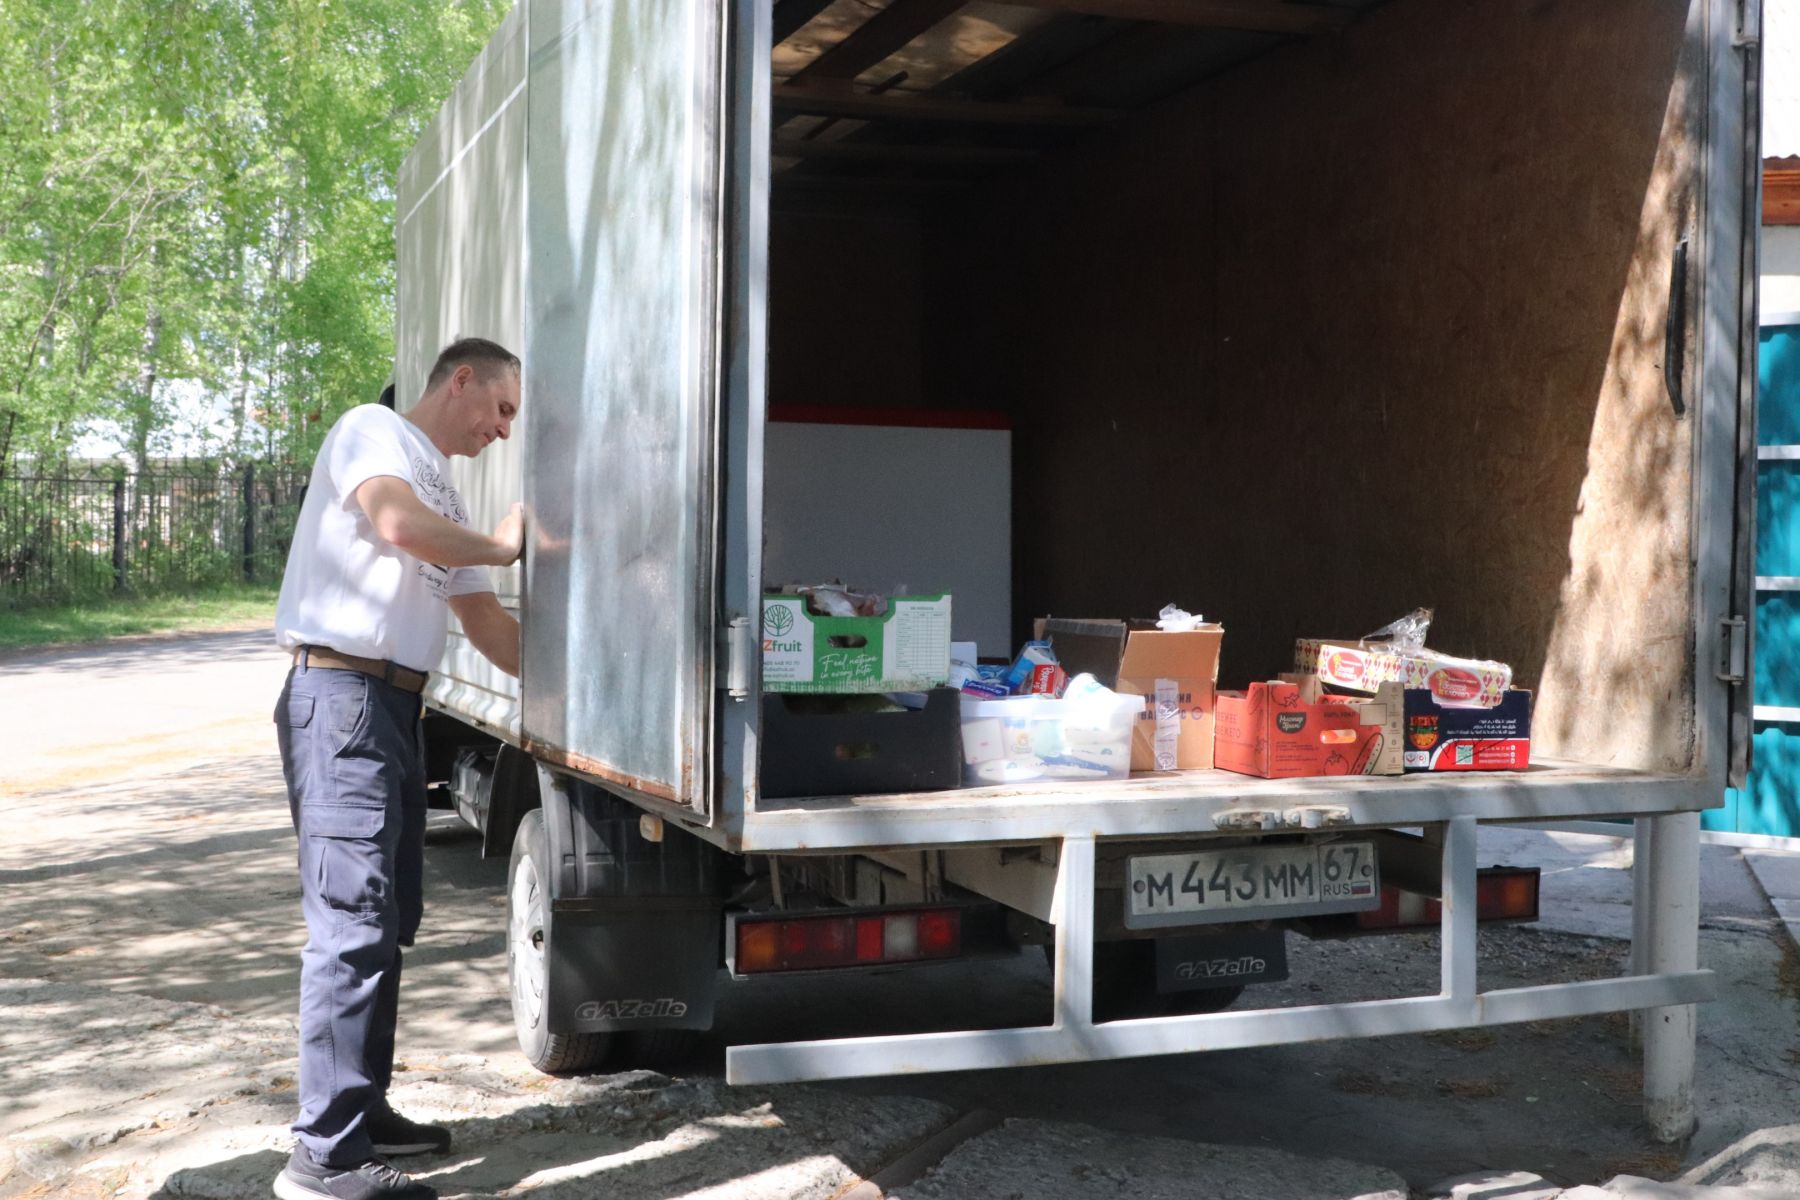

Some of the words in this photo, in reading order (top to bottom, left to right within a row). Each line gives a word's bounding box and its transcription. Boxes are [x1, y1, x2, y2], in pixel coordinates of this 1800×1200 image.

[820, 653, 848, 672] Feel
[1324, 846, 1360, 880] 67
[1323, 883, 1350, 896] RUS
[1174, 956, 1266, 979] GAZelle
[574, 998, 688, 1021] GAZelle
